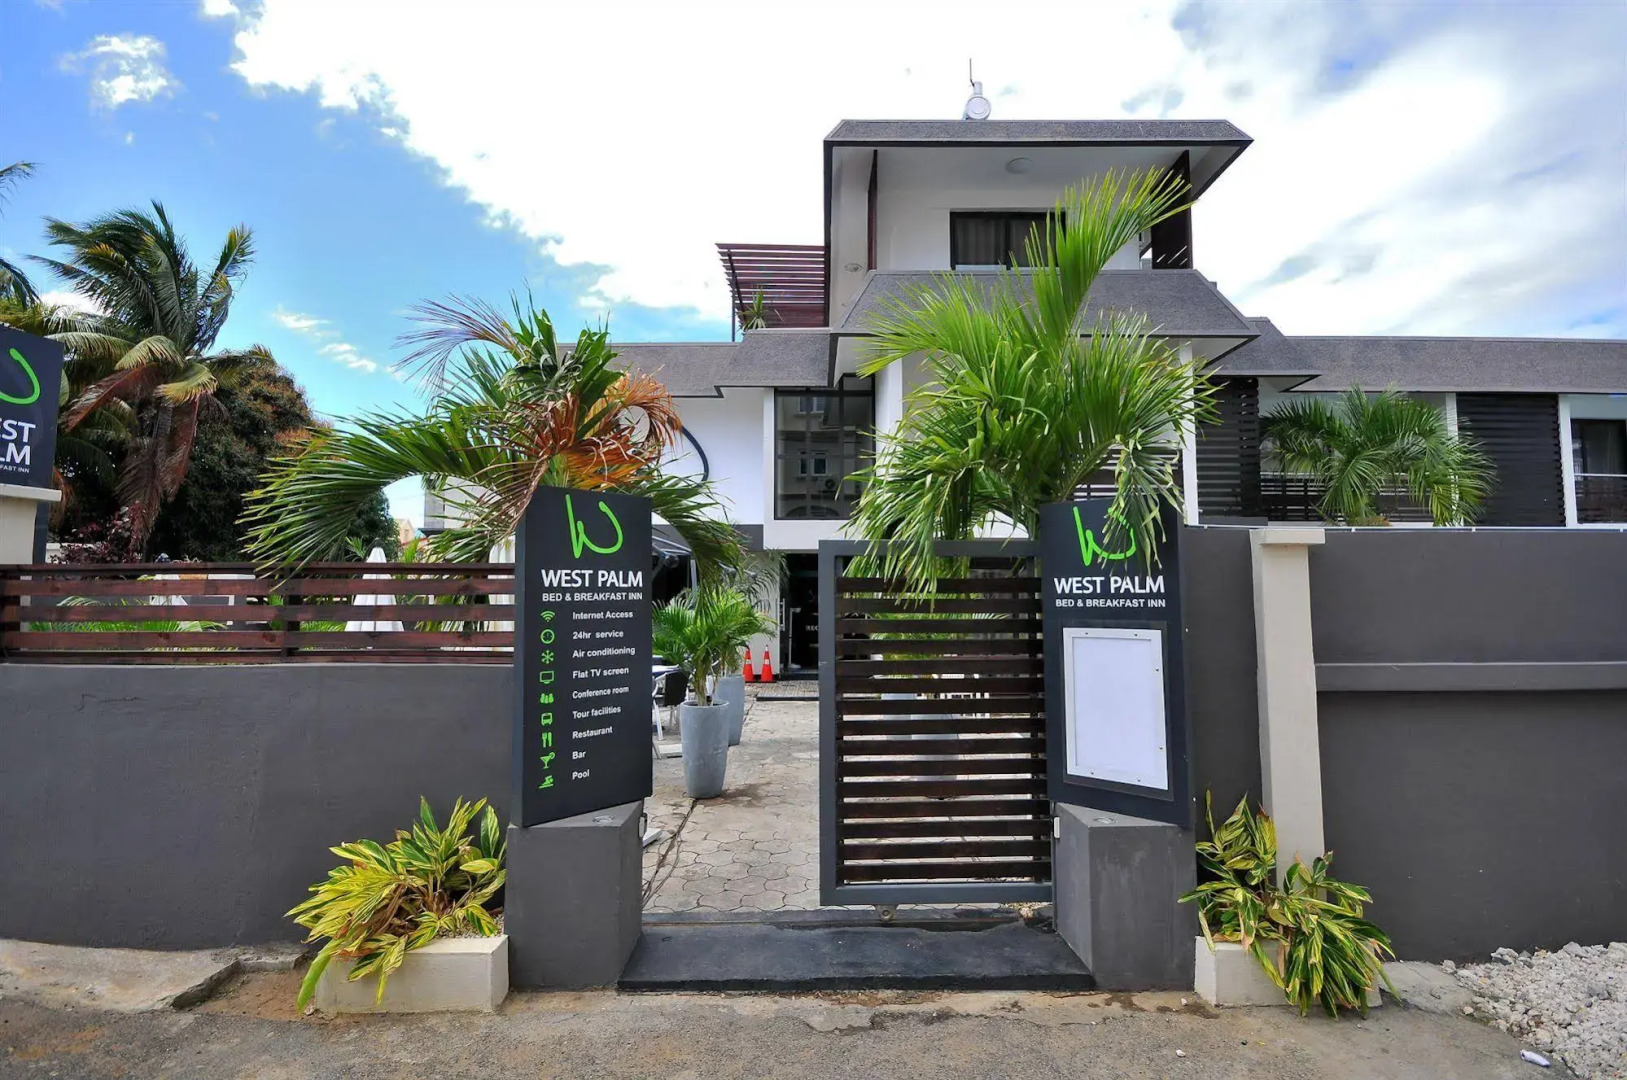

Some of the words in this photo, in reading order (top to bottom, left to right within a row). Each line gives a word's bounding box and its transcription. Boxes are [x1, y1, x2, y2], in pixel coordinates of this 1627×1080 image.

[541, 569, 594, 588] WEST
[597, 570, 643, 588] PALM
[1053, 577, 1105, 594] WEST
[1110, 575, 1165, 594] PALM
[542, 592, 563, 602] BED
[564, 593, 572, 601] &
[574, 592, 627, 601] BREAKFAST
[628, 592, 643, 600] INN
[1055, 599, 1075, 608] BED
[1076, 599, 1084, 608] &
[1085, 598, 1145, 608] BREAKFAST
[1147, 599, 1166, 608] INN
[572, 611, 604, 620] Internet
[605, 610, 634, 619] Access
[572, 631, 592, 640] 24hr
[595, 629, 624, 638] service
[572, 649, 585, 658] Air
[586, 646, 636, 657] conditioning
[572, 671, 589, 679] Flat
[589, 669, 602, 677] TV
[603, 667, 630, 676] screen
[572, 688, 611, 699] Conference
[612, 686, 630, 695] room
[572, 710, 590, 719] Tour
[591, 706, 621, 716] facilities
[572, 726, 613, 739] Restaurant
[572, 751, 586, 760] Bar
[572, 769, 590, 780] Pool
